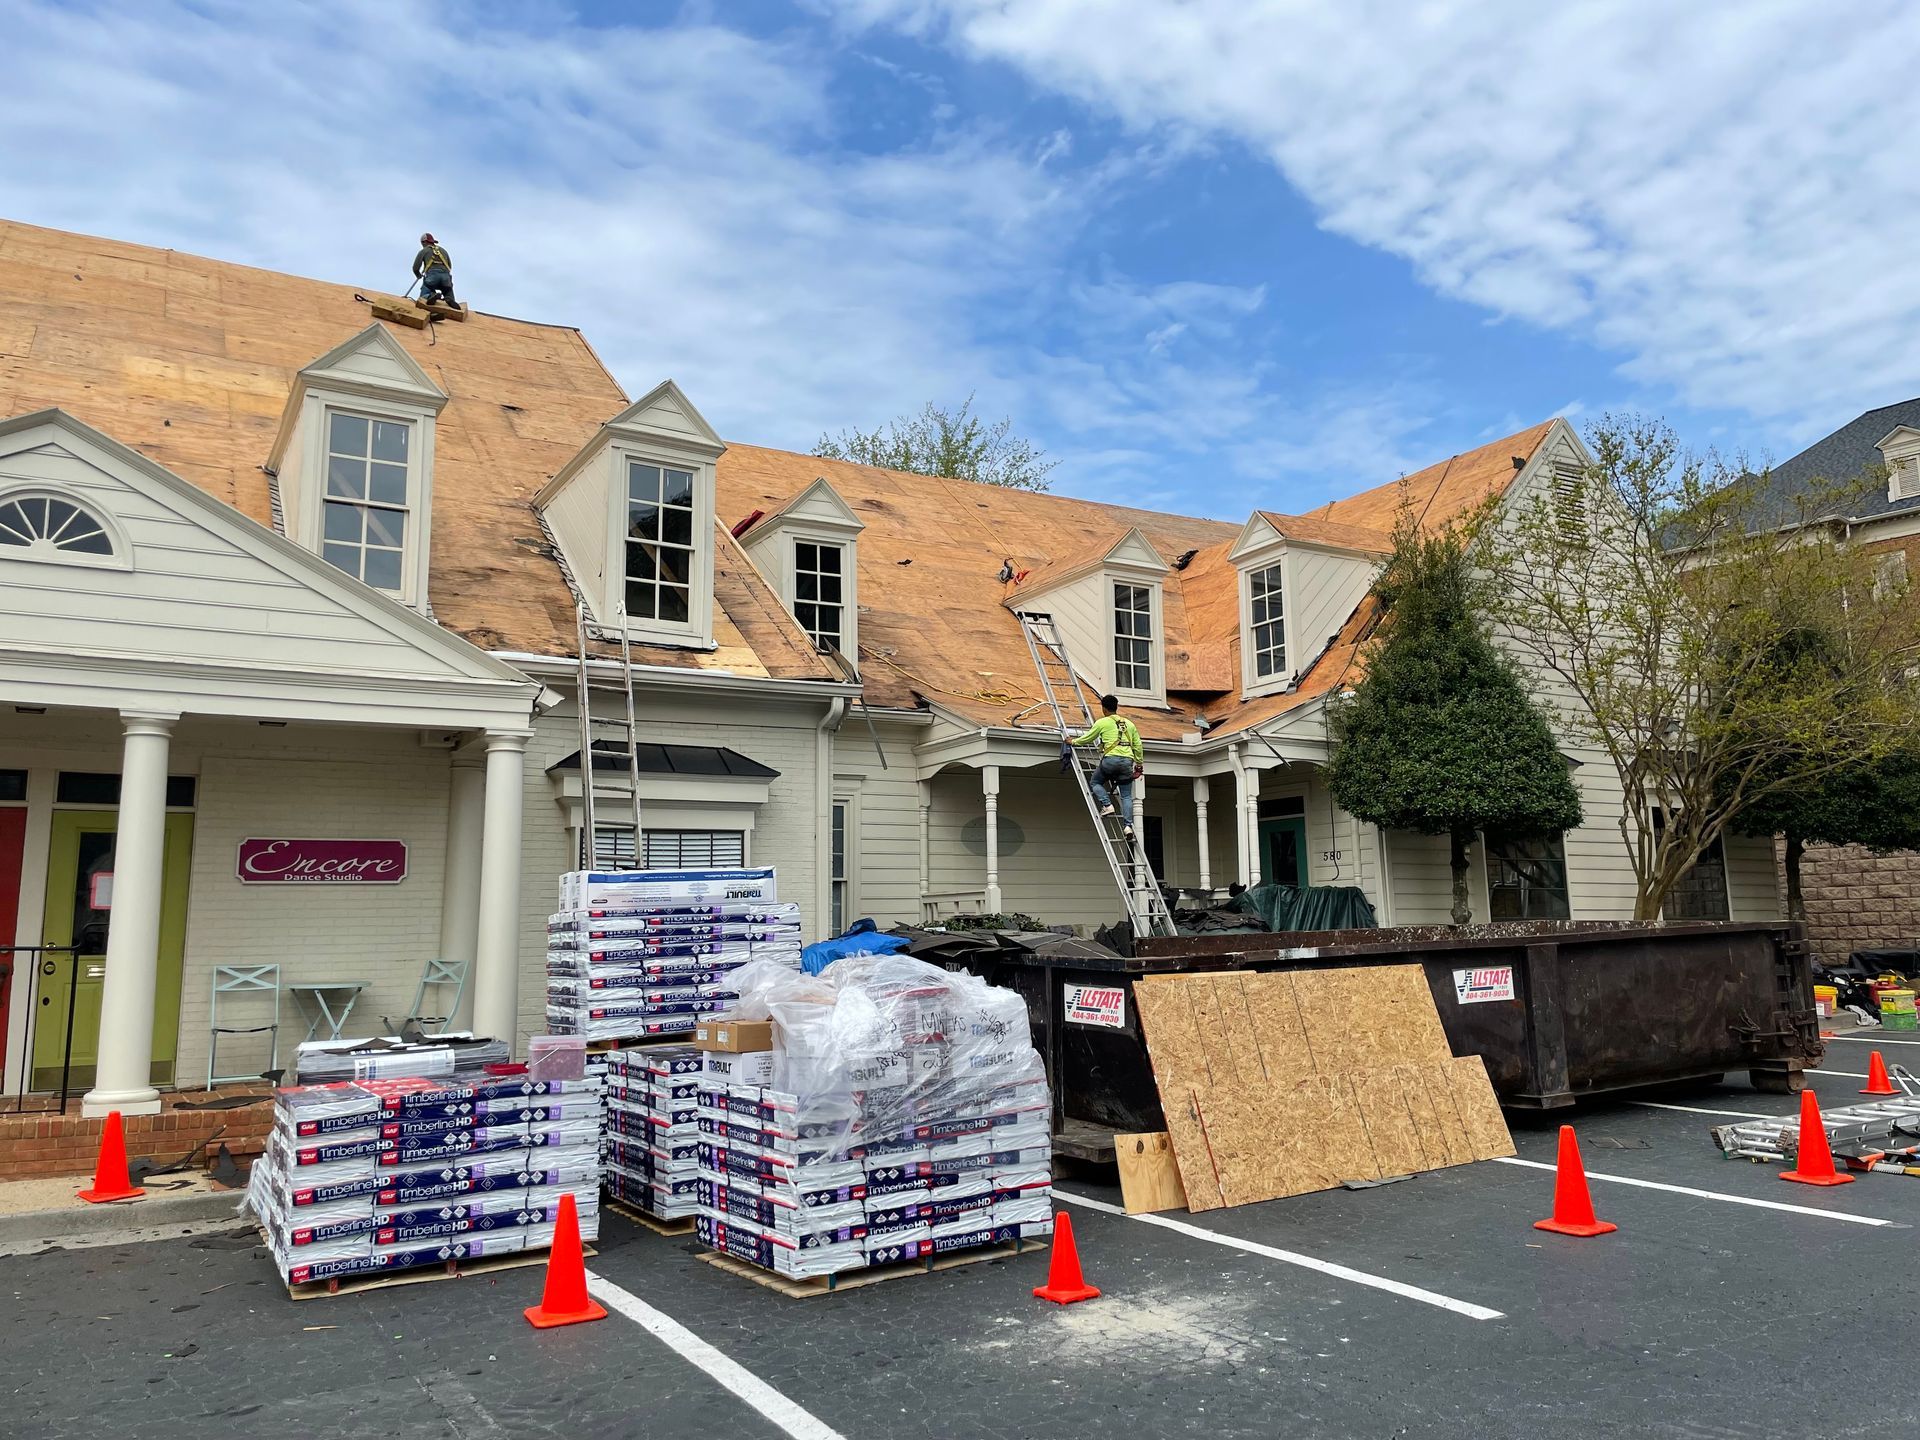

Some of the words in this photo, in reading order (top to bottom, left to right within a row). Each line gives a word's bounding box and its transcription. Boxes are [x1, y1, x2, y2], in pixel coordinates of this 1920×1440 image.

[245, 841, 399, 874] Encore
[1323, 850, 1342, 861] 580
[284, 873, 322, 881] Dance
[324, 873, 363, 881] Studio
